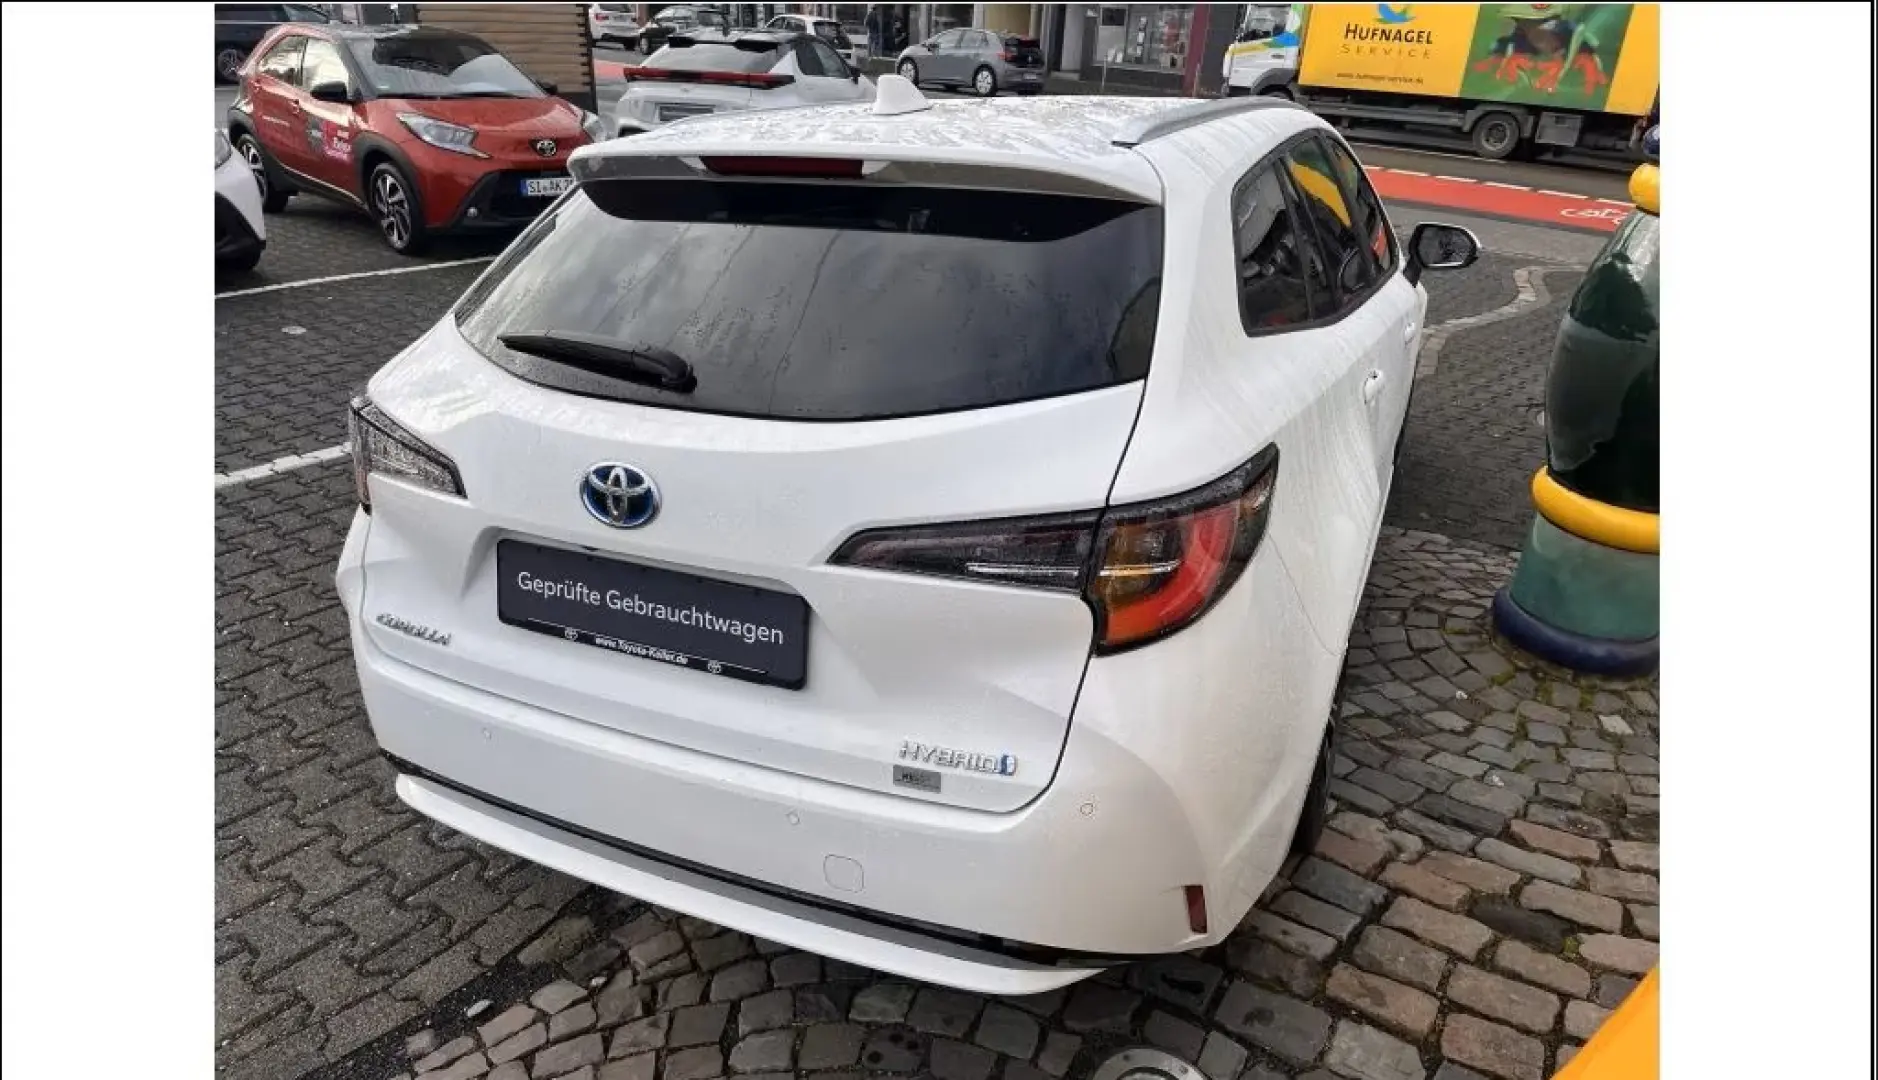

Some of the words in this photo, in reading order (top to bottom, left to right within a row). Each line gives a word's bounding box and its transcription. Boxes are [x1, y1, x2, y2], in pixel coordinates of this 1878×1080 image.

[1343, 21, 1433, 45] HUFNAGEL
[1340, 43, 1431, 60] SERVICE
[517, 571, 601, 606] Geprüfte
[606, 589, 784, 645] Gebrauchtwagen
[898, 738, 1002, 775] HYBRID
